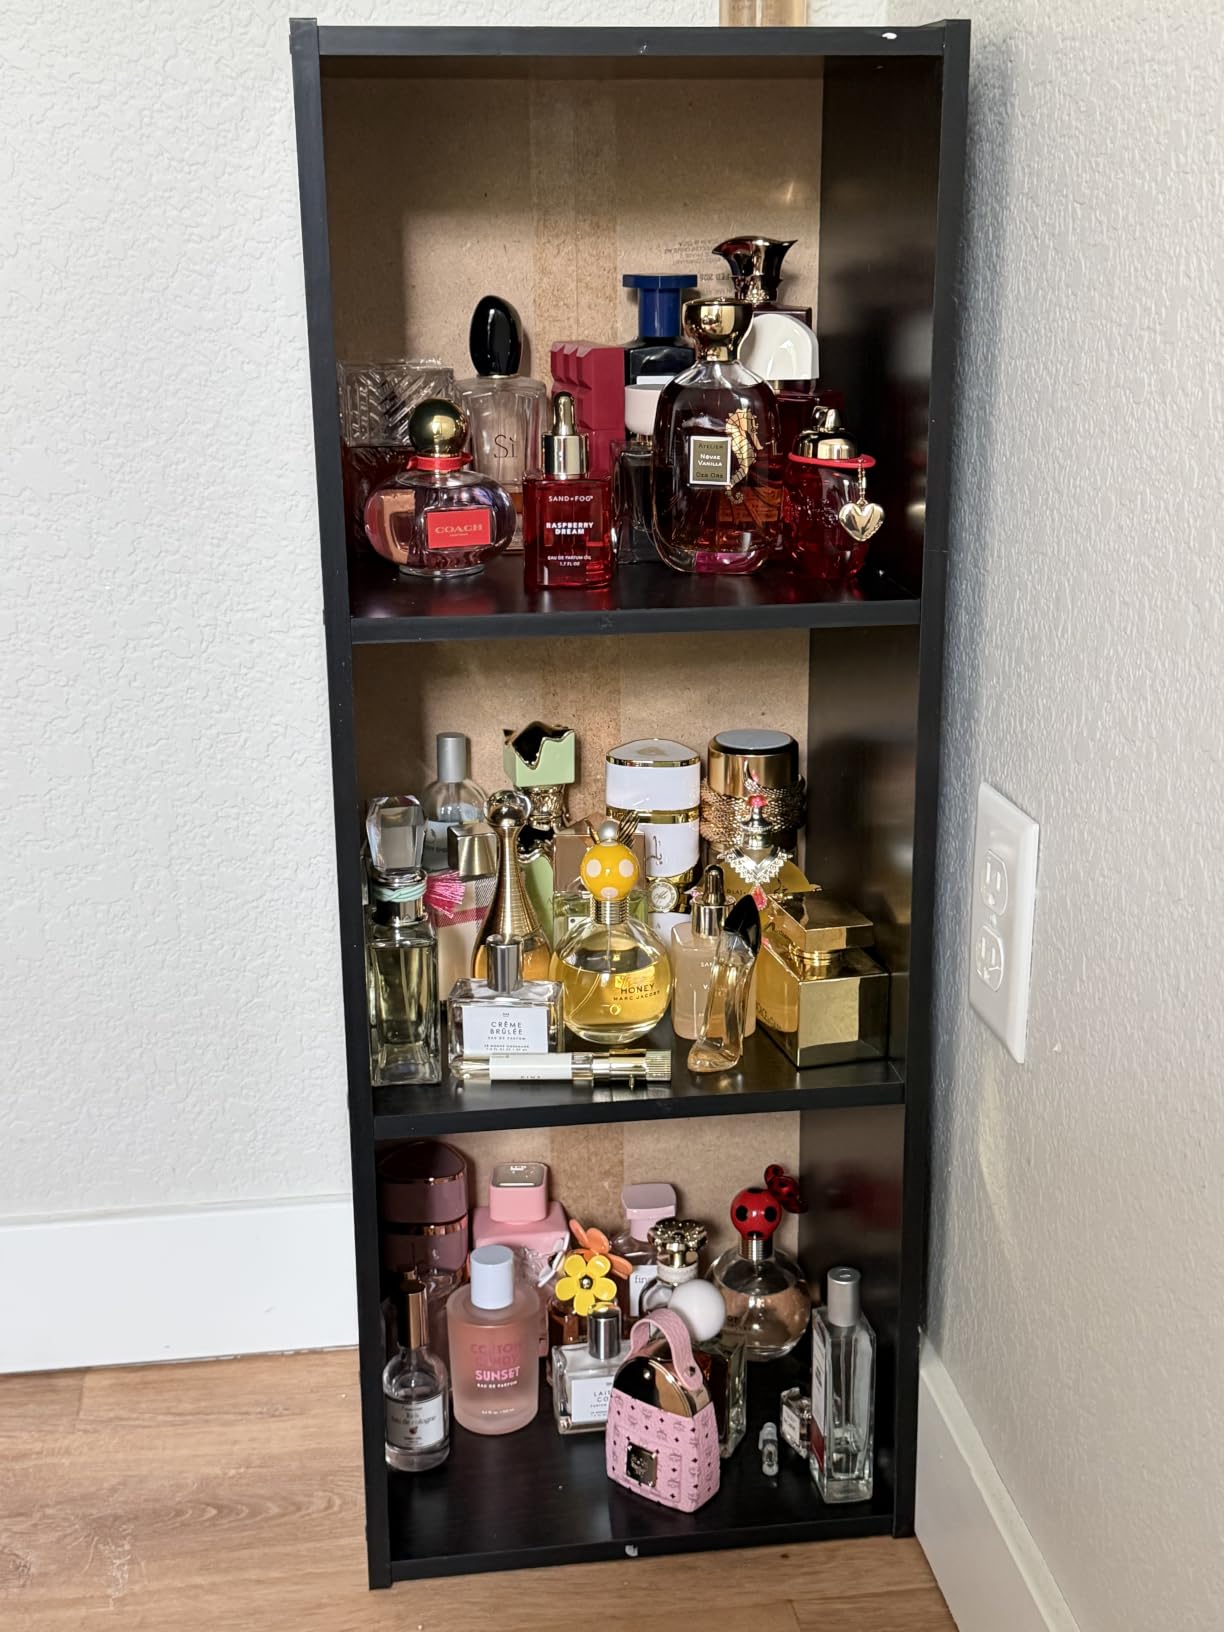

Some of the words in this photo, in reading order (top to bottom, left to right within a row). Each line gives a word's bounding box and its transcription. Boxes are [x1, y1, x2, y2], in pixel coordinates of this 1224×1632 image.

[434, 524, 483, 533] COACH
[620, 983, 655, 994] HONEY
[475, 1366, 520, 1381] SUNSET
